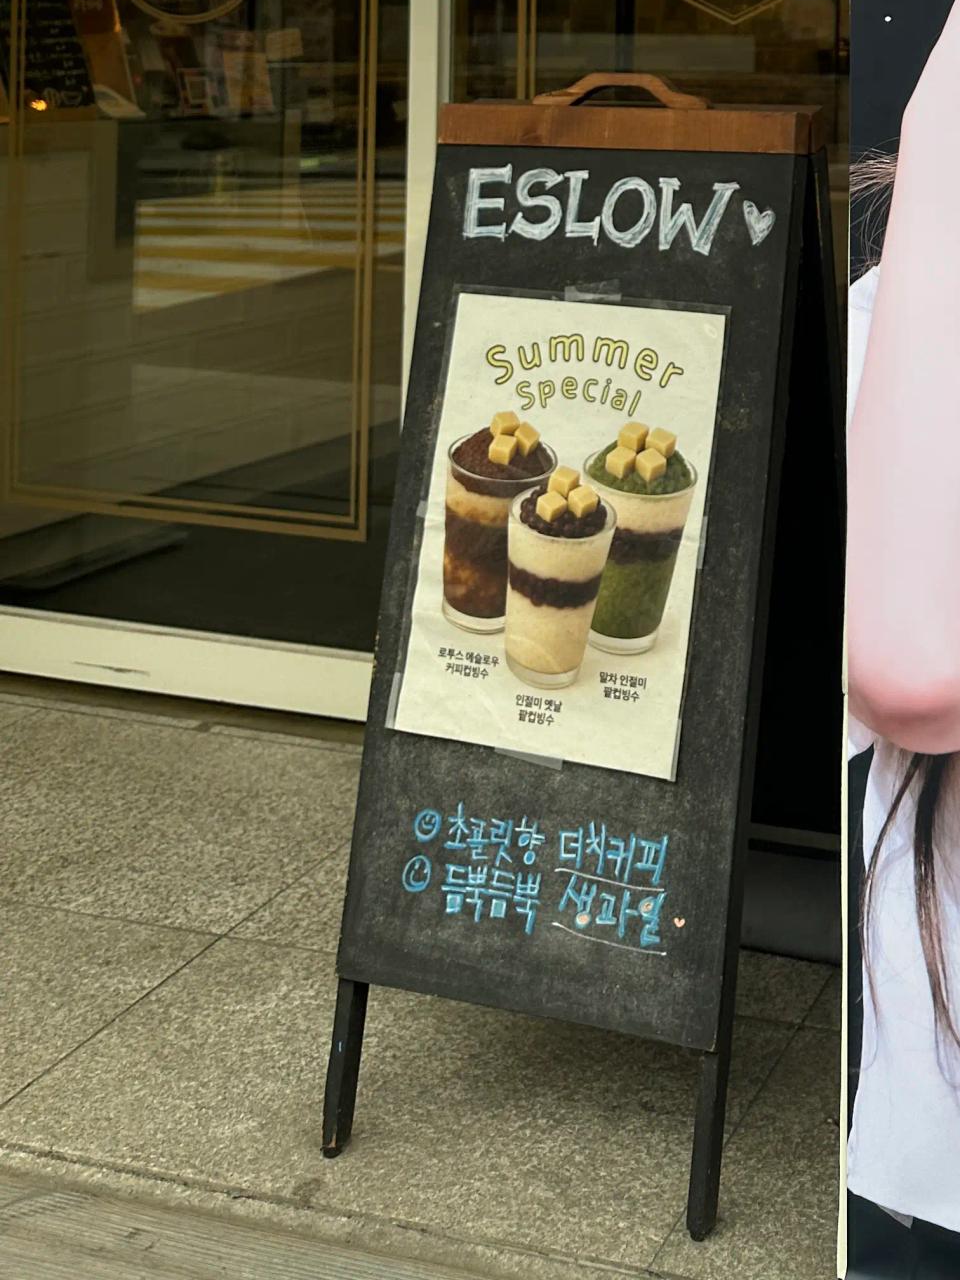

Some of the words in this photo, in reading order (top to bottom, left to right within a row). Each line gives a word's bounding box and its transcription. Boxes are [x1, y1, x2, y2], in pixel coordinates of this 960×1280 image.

[463, 163, 740, 256] ESLOW
[485, 332, 684, 389] Summer
[438, 647, 464, 661] 로투스
[465, 651, 500, 667] 에슬로우
[445, 663, 489, 680] 커피컵빙수
[599, 671, 618, 685] 말차
[619, 674, 648, 690] 인절미
[515, 694, 543, 710] 인절미
[544, 699, 563, 713] 옛날
[443, 801, 546, 866] 초콜릿향
[559, 822, 669, 885] 더치커피
[441, 863, 542, 935] 듬뿍듬뿍
[558, 875, 668, 948] 생과일
